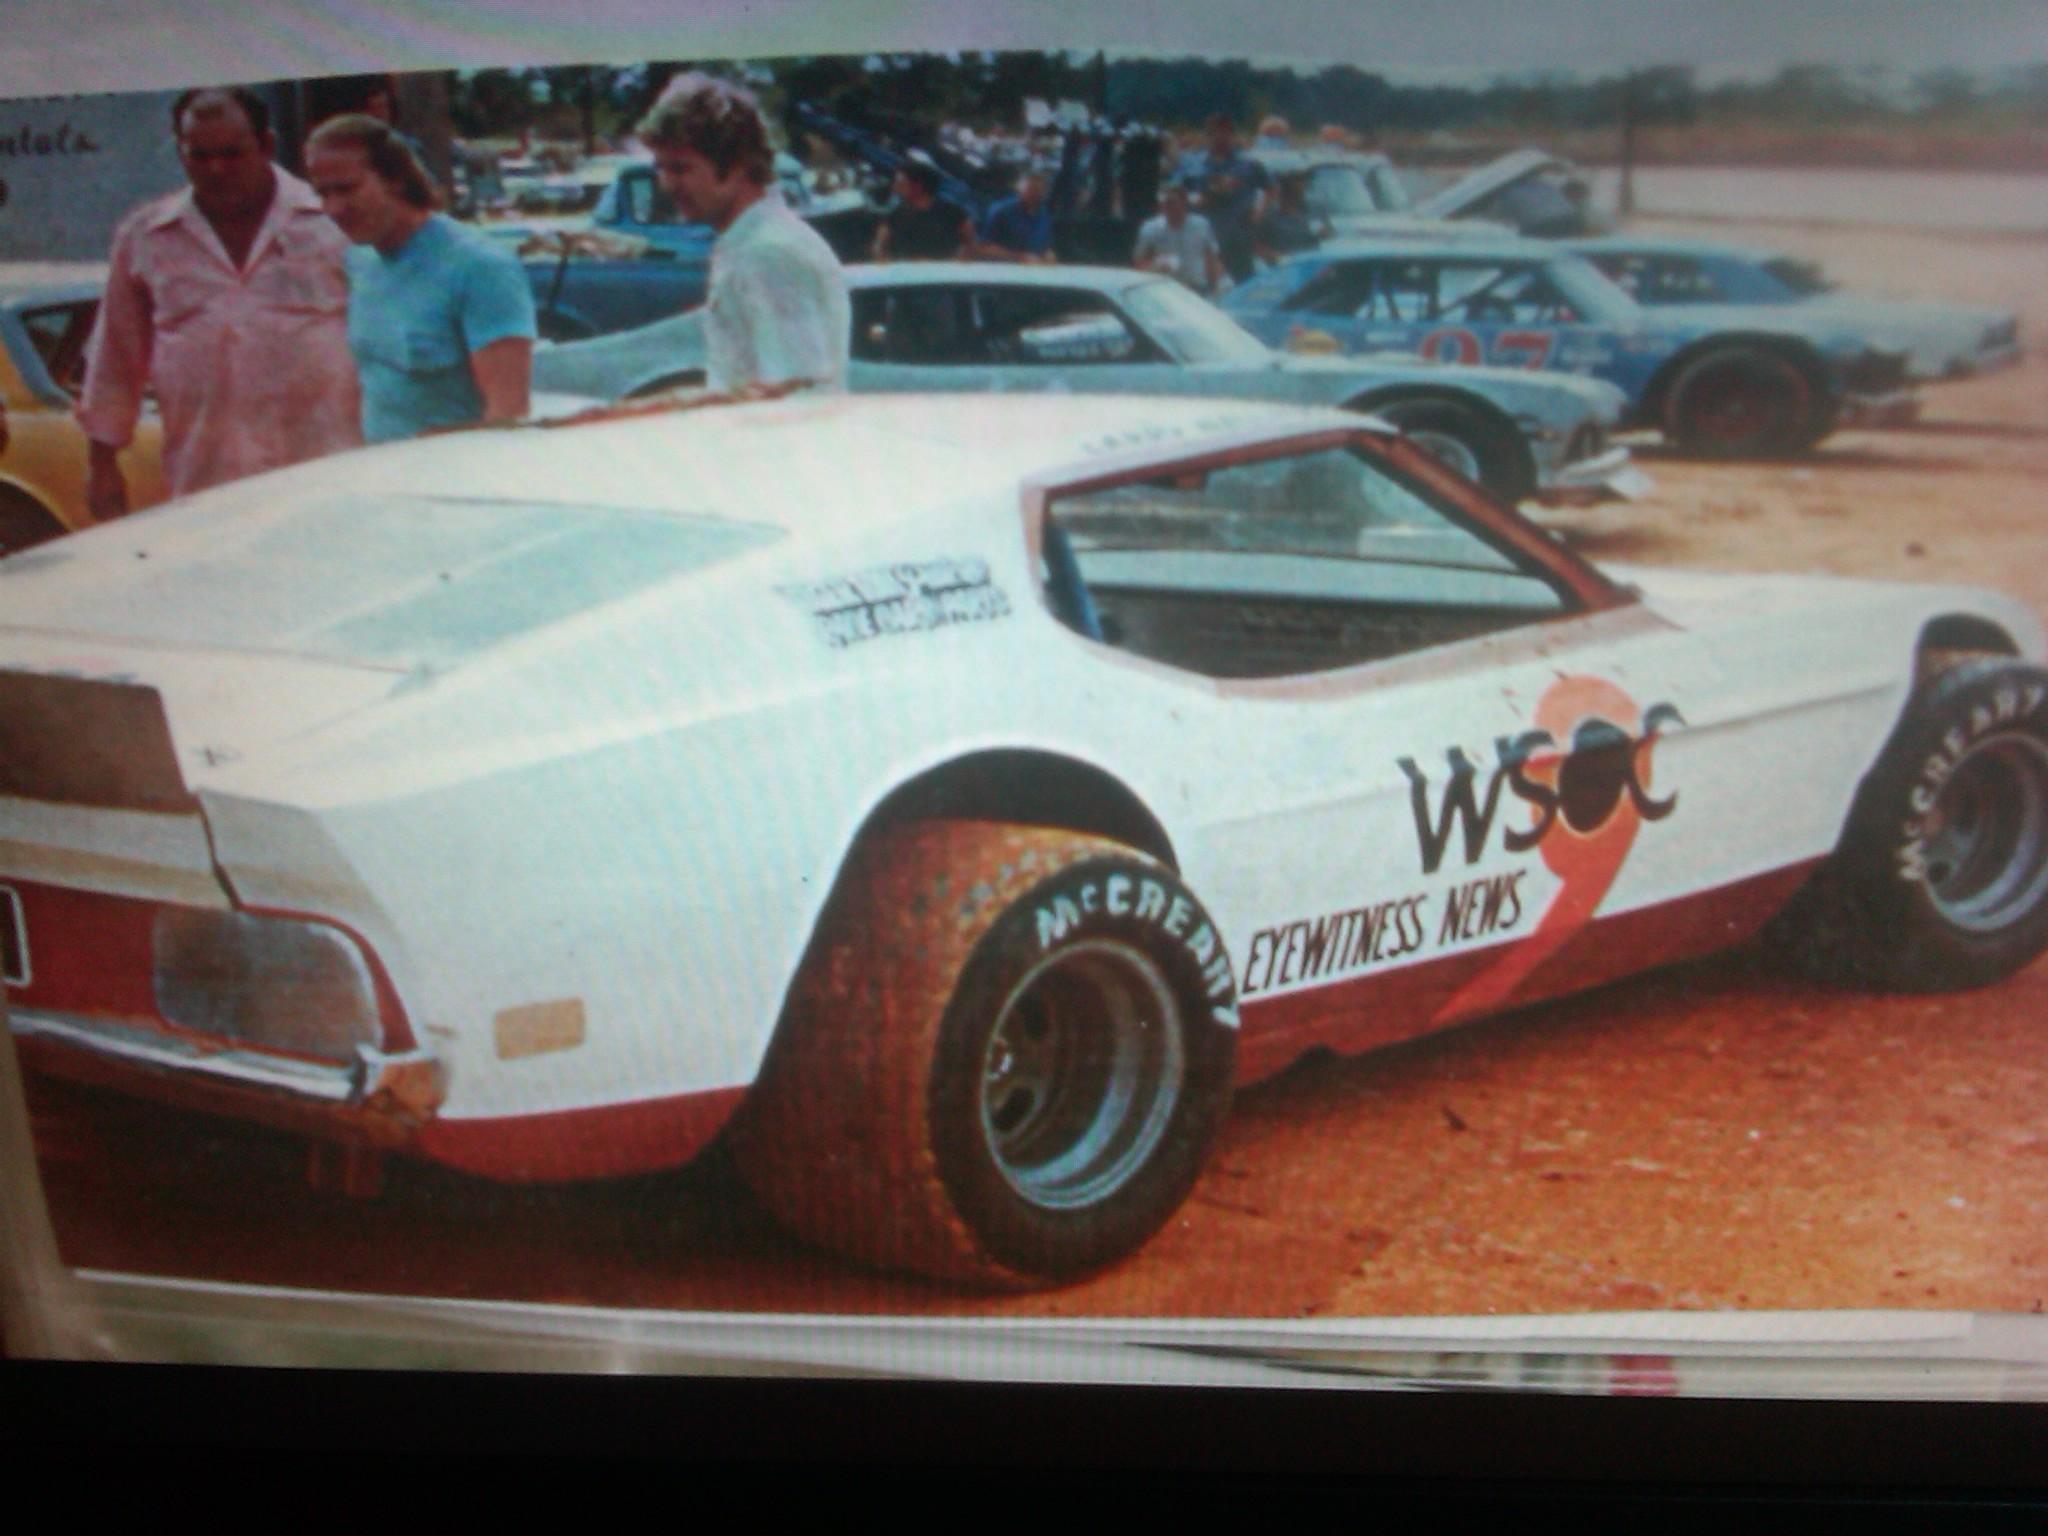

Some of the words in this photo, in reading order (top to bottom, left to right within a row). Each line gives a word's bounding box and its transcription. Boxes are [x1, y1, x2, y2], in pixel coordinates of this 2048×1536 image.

[1396, 702, 1687, 875] WSOC
[1242, 893, 1428, 996] EYEWITNESS
[1438, 869, 1528, 945] NEWS
